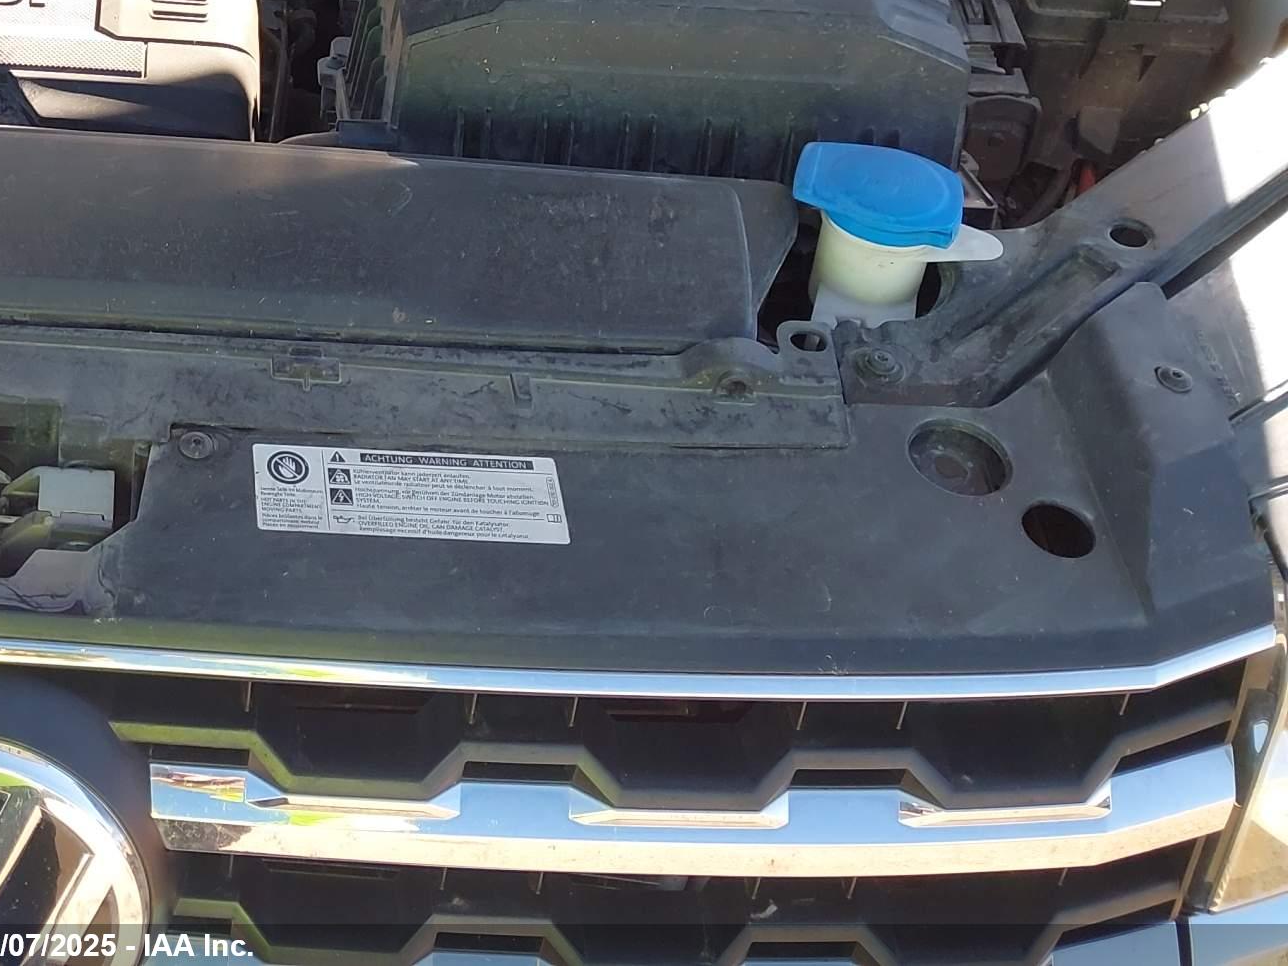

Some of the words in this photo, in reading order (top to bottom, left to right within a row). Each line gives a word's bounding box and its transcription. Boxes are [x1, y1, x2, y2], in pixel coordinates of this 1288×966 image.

[365, 454, 413, 465] ACHTUNG
[418, 457, 468, 467] WARNING
[473, 459, 527, 470] ATTENTION
